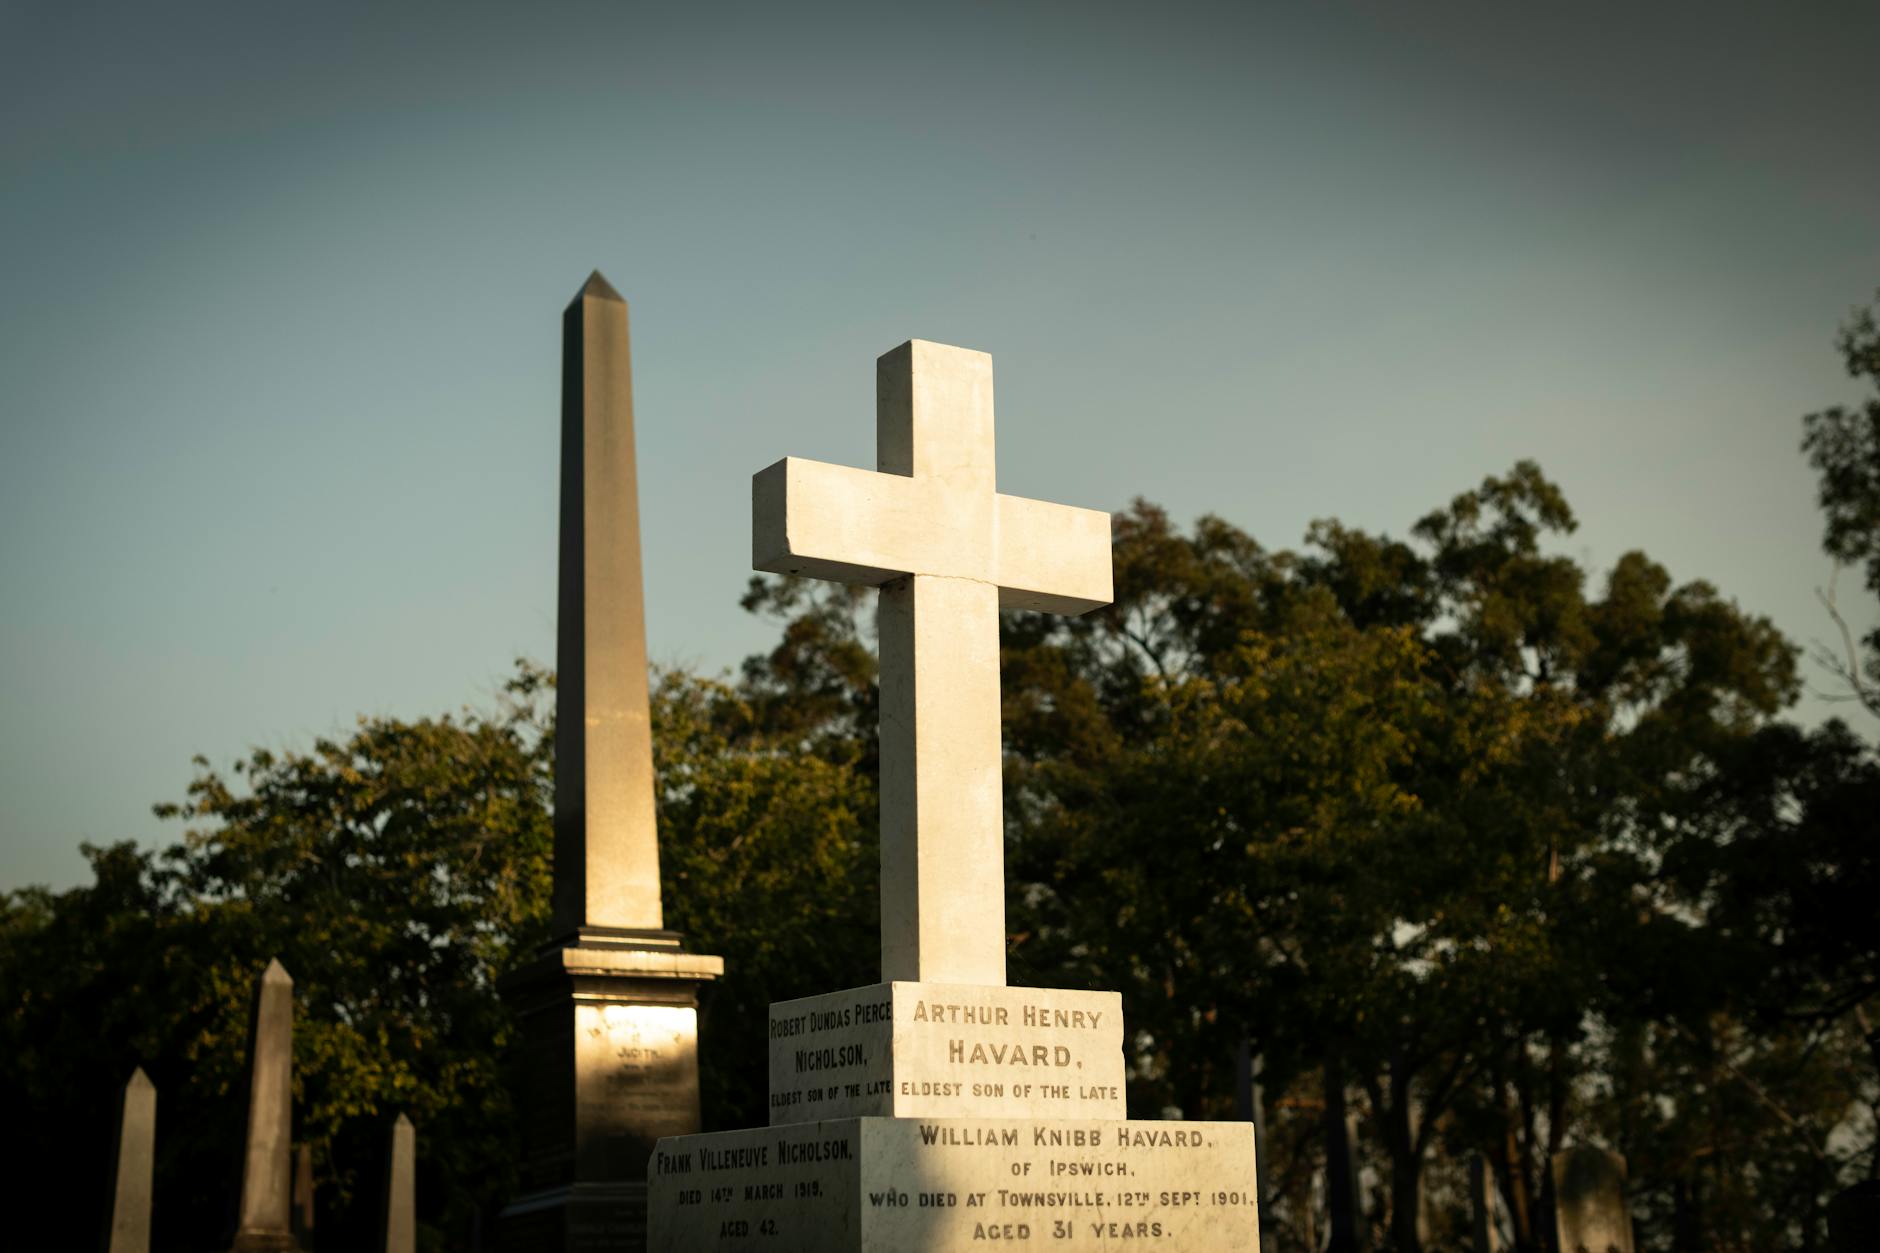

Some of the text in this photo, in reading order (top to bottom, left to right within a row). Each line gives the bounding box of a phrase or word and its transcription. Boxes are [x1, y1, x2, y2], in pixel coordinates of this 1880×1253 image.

[770, 1001, 892, 1040] ROBERT DUNDAS PIERCE
[913, 1000, 1103, 1029] ARTHUR HENRY
[949, 1039, 1083, 1069] HAVARD,
[771, 1080, 891, 1108] ELDEST SON OF THE LATE
[901, 1082, 1118, 1100] ELDEST SON OF THE LATE
[920, 1125, 1213, 1148] WILLIAM KNIBB HAVARD,
[657, 1152, 692, 1175] FRANK
[700, 1147, 768, 1171] VILLENEUVE
[1011, 1160, 1136, 1177] OF IPSWICH,
[679, 1190, 702, 1205] DIED
[745, 1183, 783, 1200] MARCH
[869, 1190, 909, 1207] WHO
[919, 1193, 957, 1207] DIED
[966, 1193, 986, 1207] AT
[1118, 1192, 1150, 1207] 12TH
[720, 1220, 749, 1239] AGED
[973, 1221, 1172, 1241] AGED 31 YEARS.
